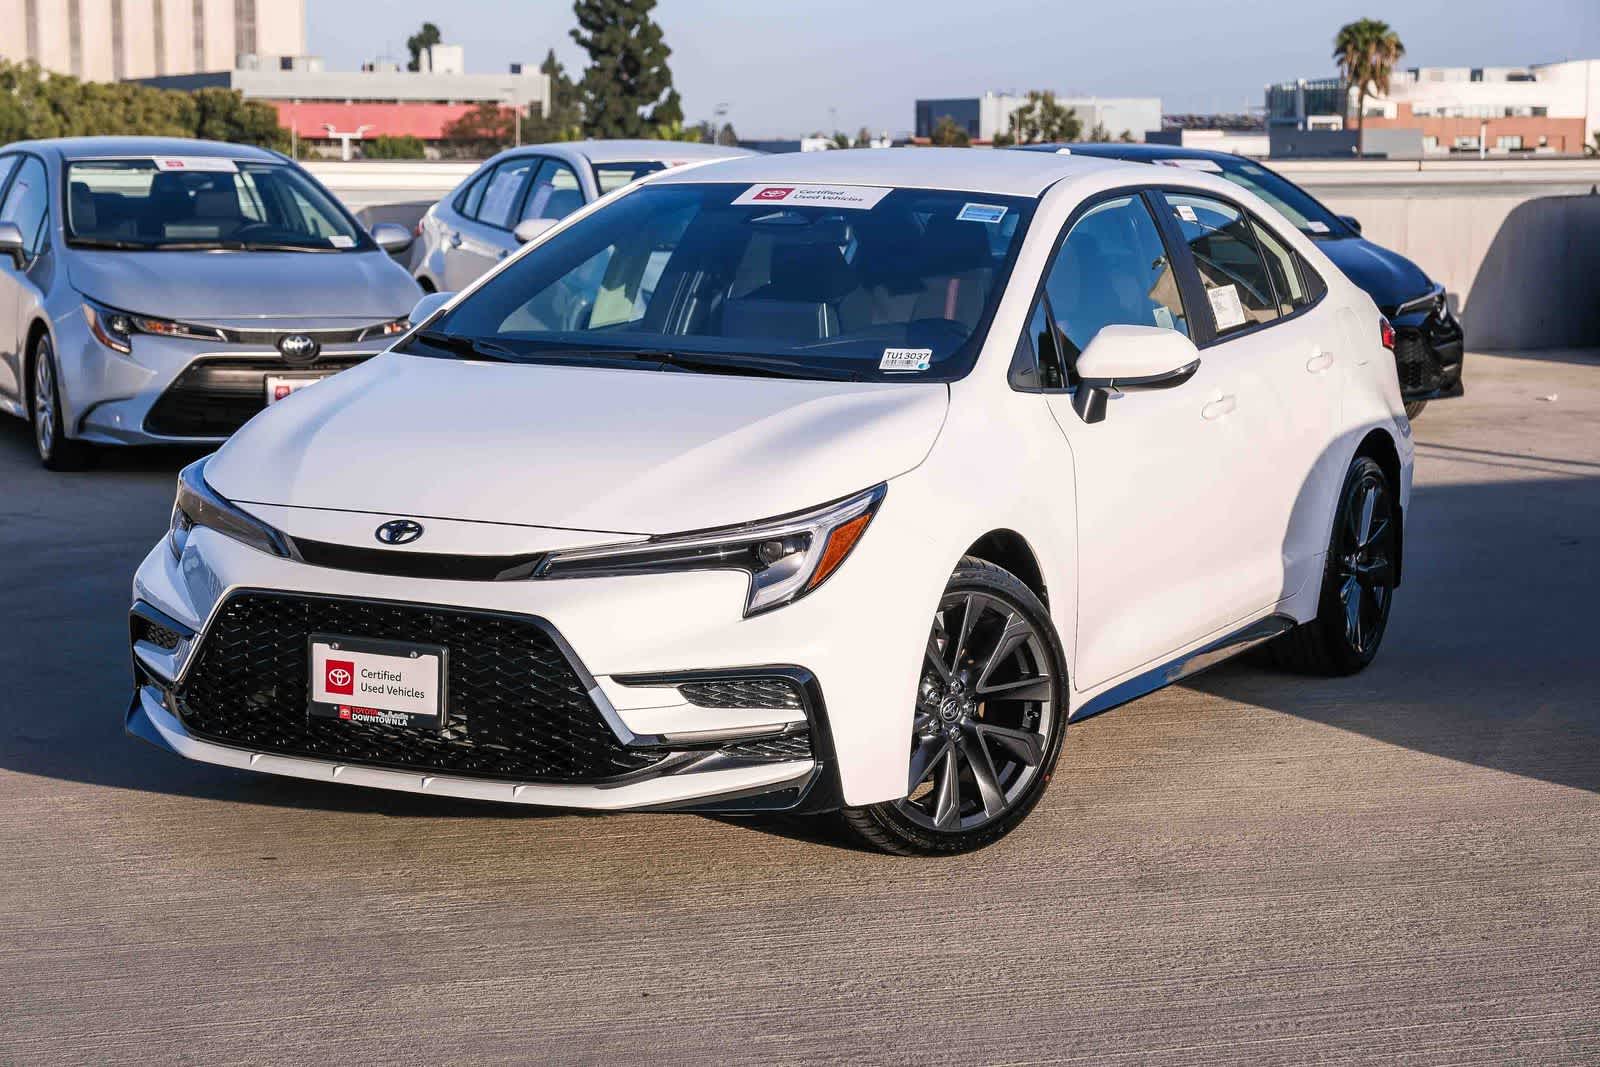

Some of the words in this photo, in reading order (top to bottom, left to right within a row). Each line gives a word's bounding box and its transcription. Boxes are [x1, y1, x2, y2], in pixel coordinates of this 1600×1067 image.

[886, 351, 930, 360] TU13037
[361, 668, 402, 682] Certified
[361, 682, 384, 694] Used
[387, 685, 425, 699] Vehicles
[352, 706, 379, 716] TOYOTA
